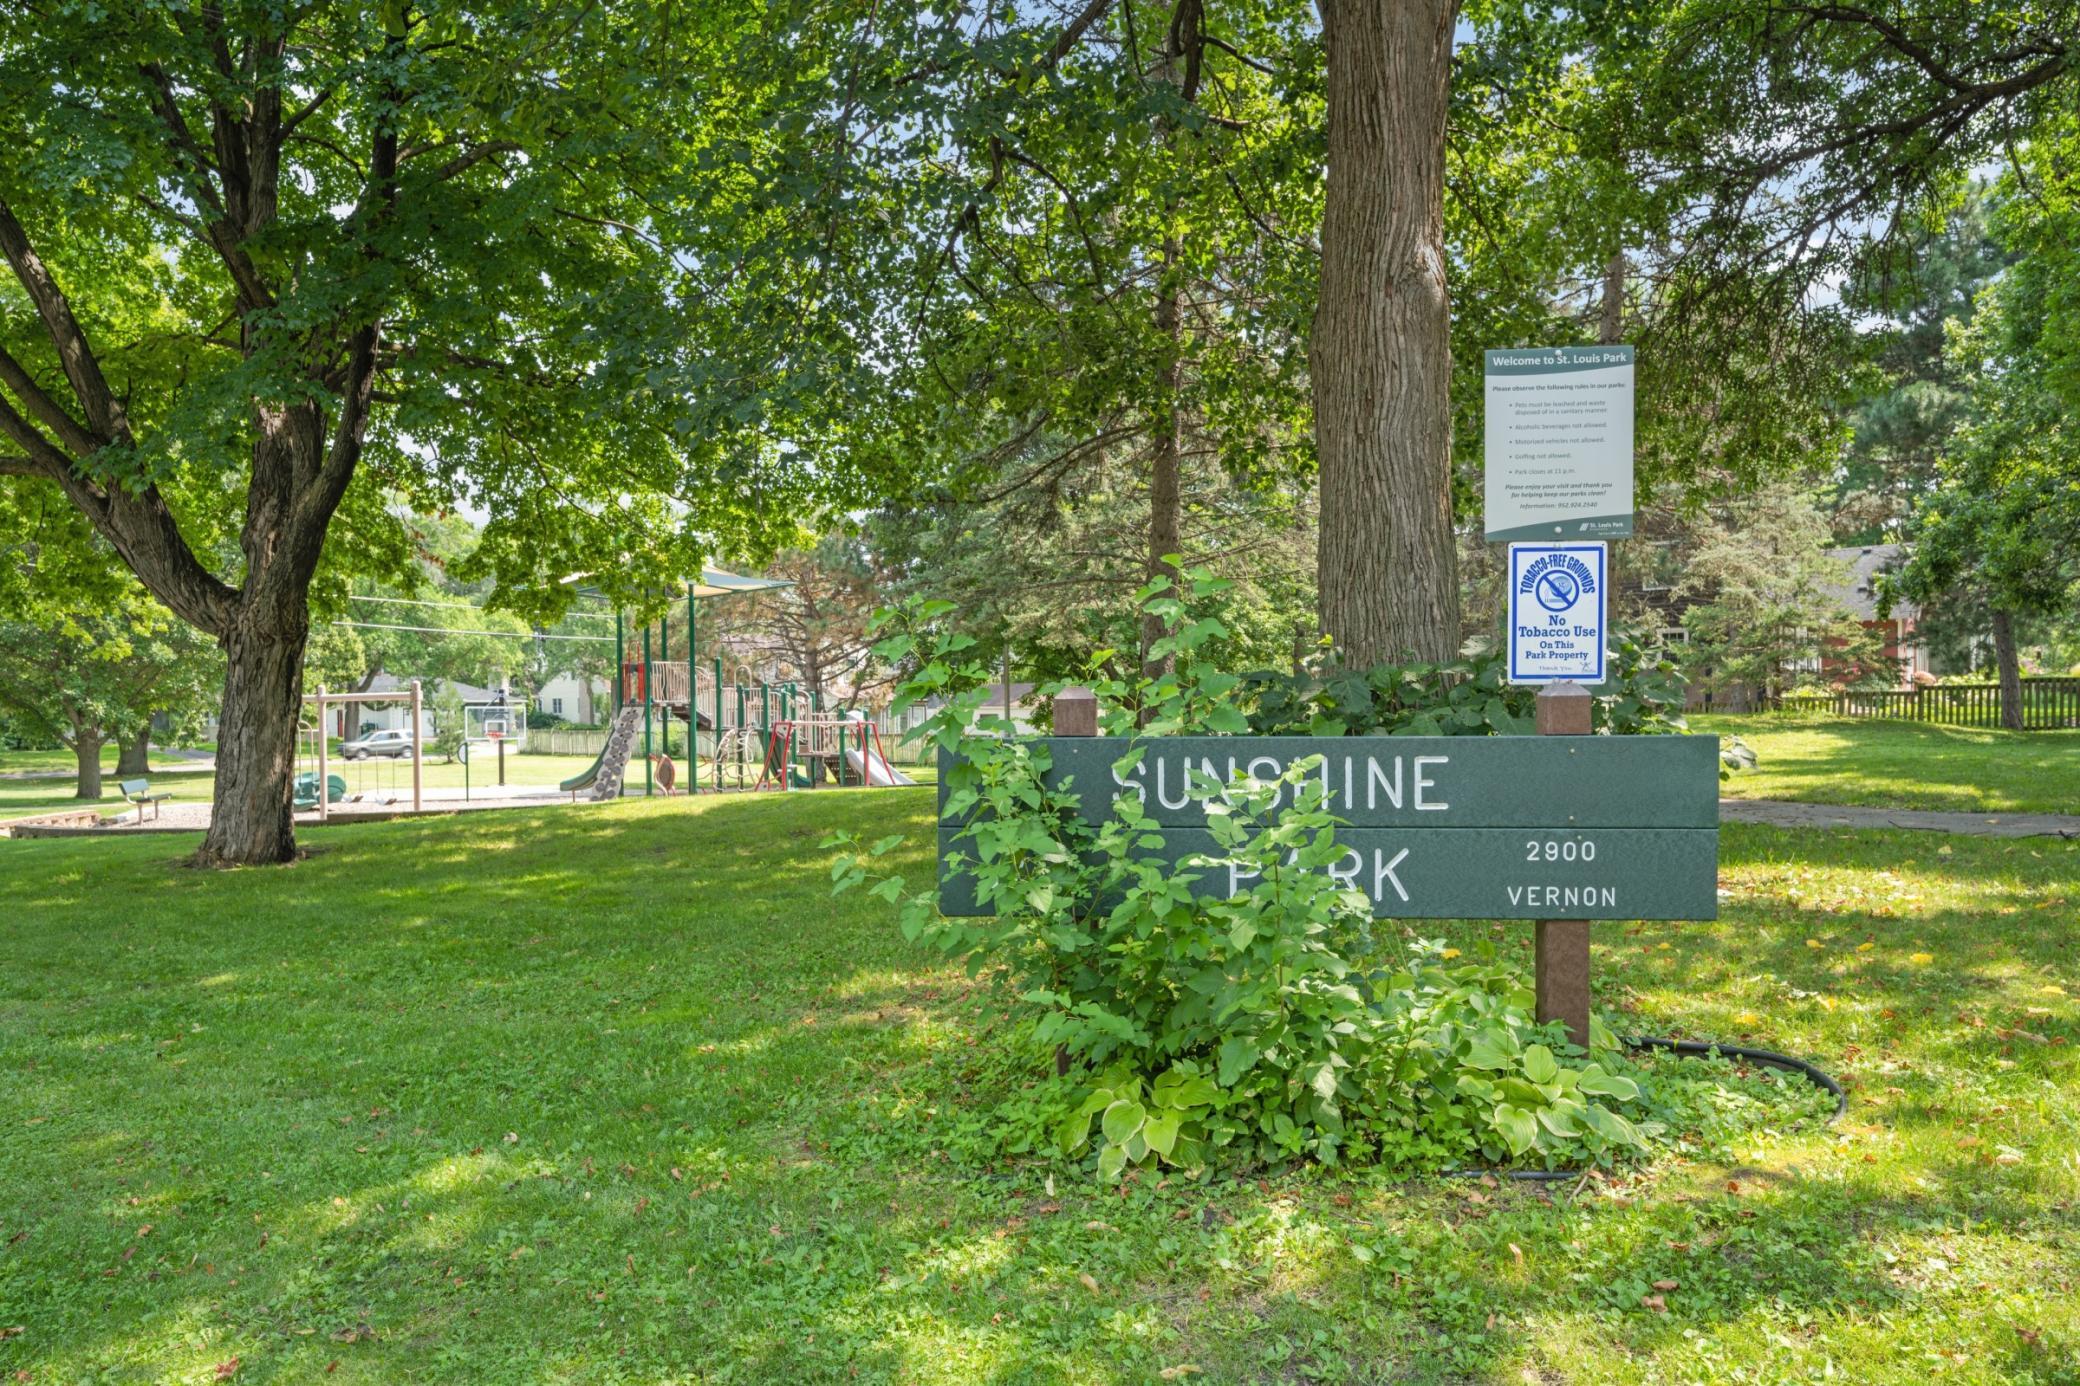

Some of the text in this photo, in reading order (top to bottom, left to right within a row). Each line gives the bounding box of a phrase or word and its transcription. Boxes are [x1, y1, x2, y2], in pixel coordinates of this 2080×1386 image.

[1492, 352, 1627, 367] Welcome to St. Louis Park
[1520, 554, 1596, 595] TOBACCO-FREE GROUNDS
[1548, 614, 1566, 626] No
[1518, 625, 1596, 637] Tobacco Use
[1539, 640, 1575, 649] On This
[1525, 650, 1589, 661] Park Property
[1112, 756, 1450, 811] SUNSHINE
[1526, 841, 1596, 861] 2900
[1229, 848, 1410, 902] PRK
[1507, 886, 1616, 907] VERNON
